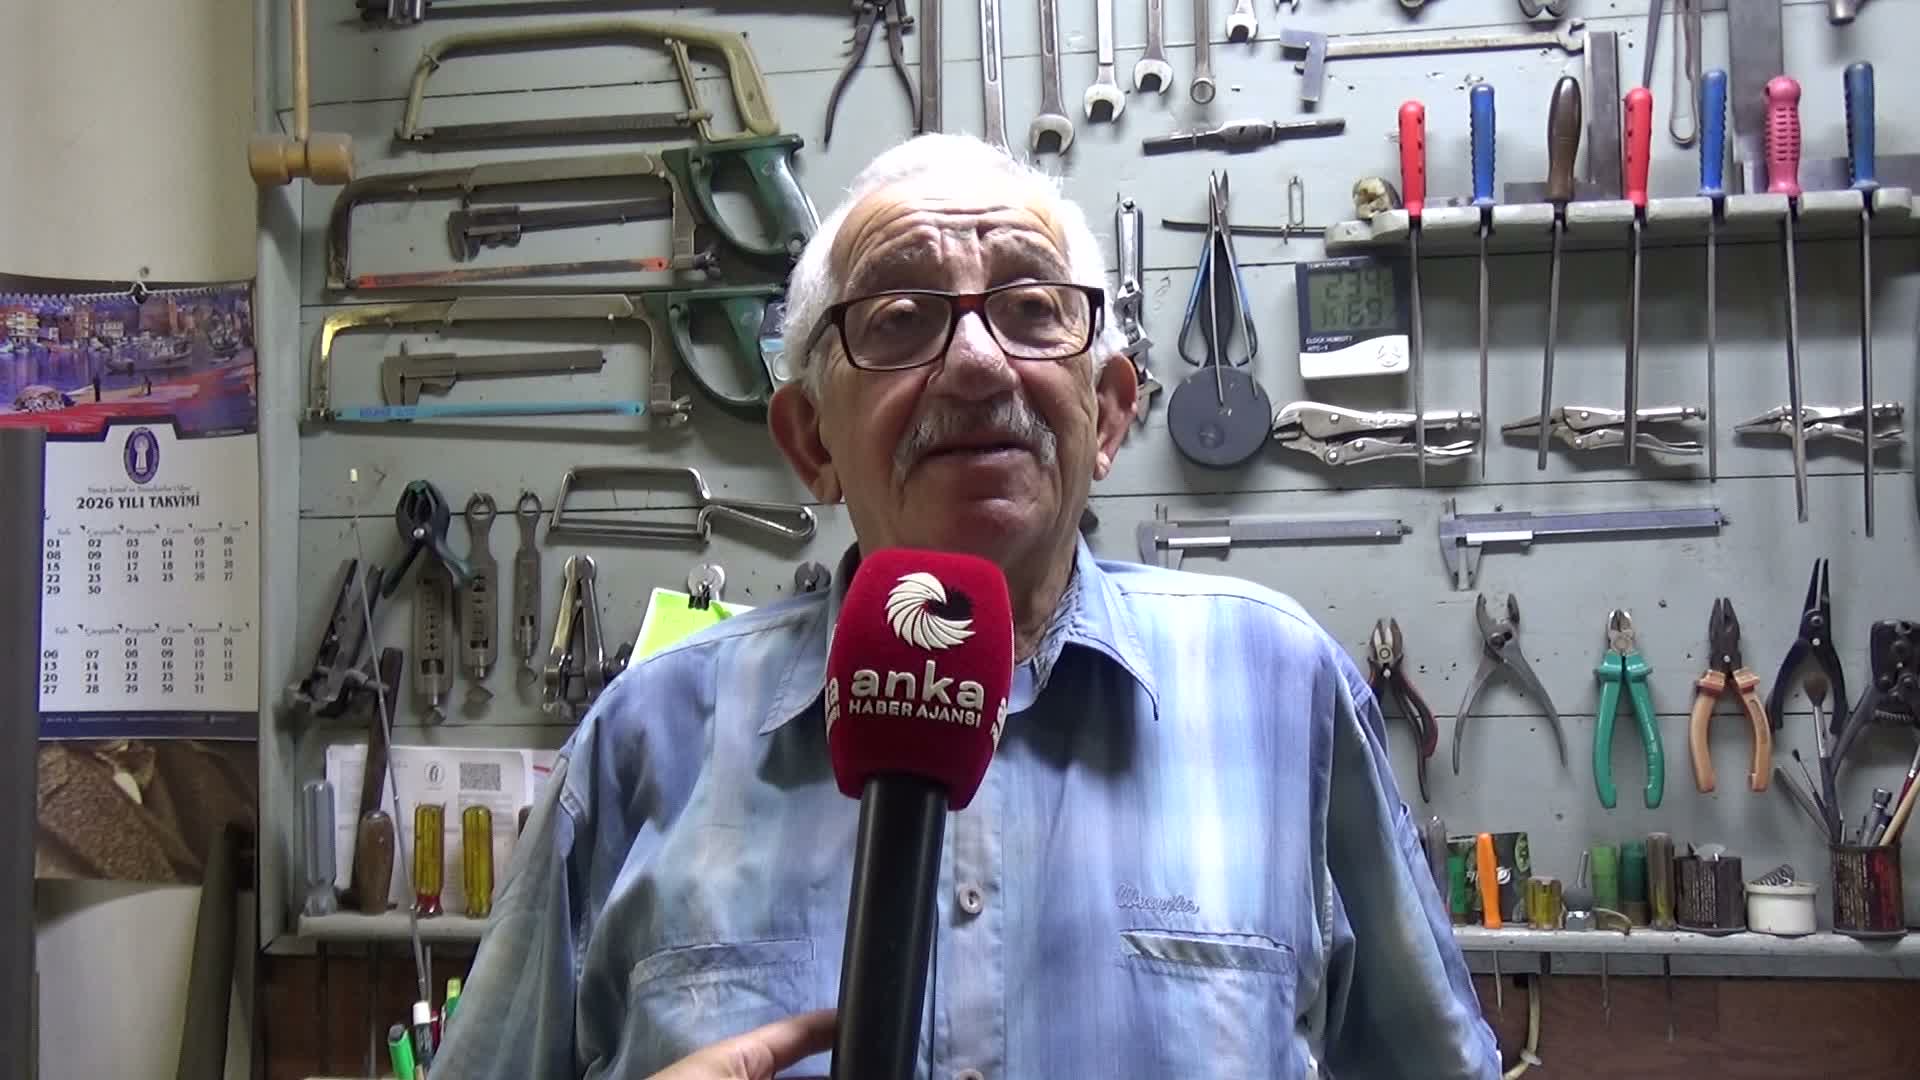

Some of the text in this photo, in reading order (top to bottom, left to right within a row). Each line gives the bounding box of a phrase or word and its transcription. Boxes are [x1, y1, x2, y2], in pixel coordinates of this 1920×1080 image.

[77, 491, 200, 509] 2026 YILI TAKVİMİ
[47, 539, 61, 548] 01
[88, 539, 101, 548] 02
[47, 551, 61, 560] 08
[88, 551, 101, 560] 09
[47, 562, 61, 571] 15
[88, 562, 101, 571] 16
[47, 574, 61, 583] 22
[88, 574, 101, 583] 23
[47, 586, 101, 595] 29 30
[43, 650, 58, 659] 06
[85, 650, 99, 659] 07
[43, 661, 58, 670] 13
[85, 661, 99, 670] 14
[43, 673, 58, 682] 20
[85, 673, 99, 682] 21
[43, 684, 58, 694] 27
[85, 684, 99, 694] 28
[851, 660, 985, 711] anka
[849, 700, 981, 728] HABER AJANSI
